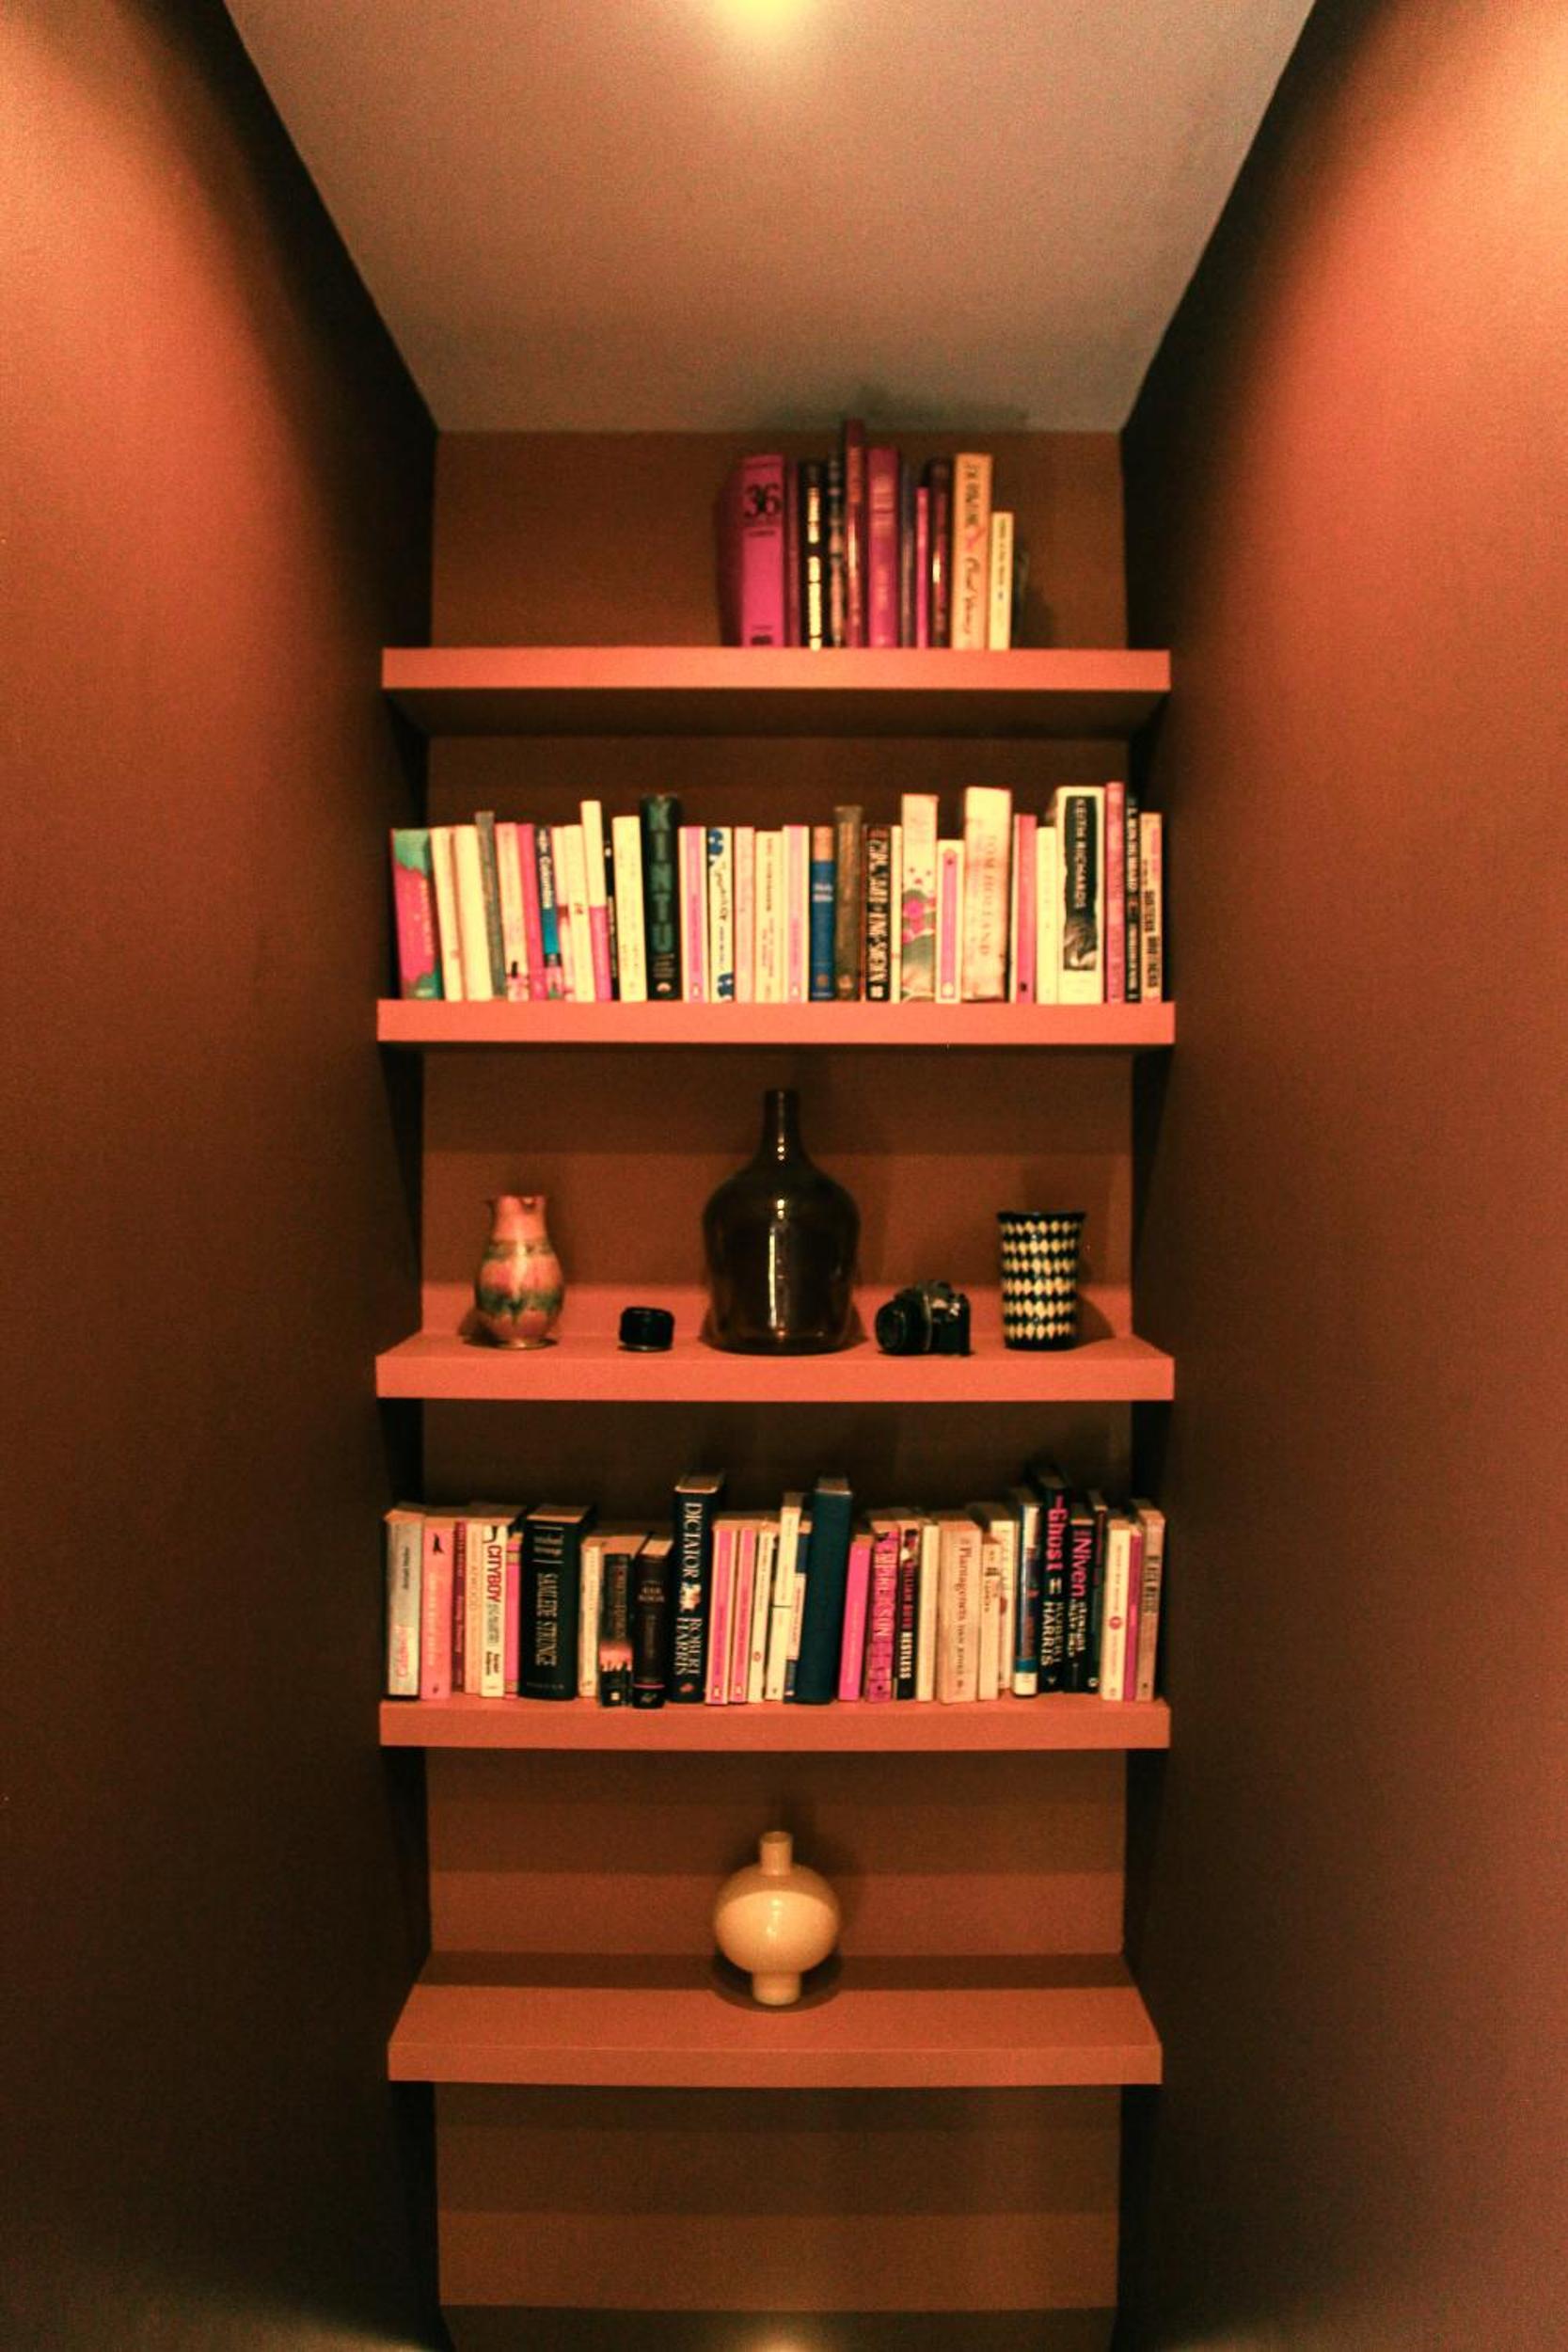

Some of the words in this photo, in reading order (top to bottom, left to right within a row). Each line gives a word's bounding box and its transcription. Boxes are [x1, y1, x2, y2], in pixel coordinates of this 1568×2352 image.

[1076, 799, 1087, 839] KEITH
[1075, 841, 1087, 910] RICHARDS
[981, 875, 996, 957] HOLLAND
[682, 1502, 704, 1580] DICTATOR
[1046, 1507, 1069, 1572] Ghost
[1070, 1538, 1092, 1597] Niven
[486, 1545, 502, 1602] CITYBOY
[536, 1573, 559, 1616] SAMLEDE
[954, 1547, 972, 1620] Plantagenets
[535, 1621, 558, 1665] STRUNGE
[674, 1617, 690, 1676] HARRIS
[688, 1617, 704, 1675] ROBERT
[900, 1631, 913, 1678] RESTLESS
[1041, 1601, 1056, 1666] HARRIS
